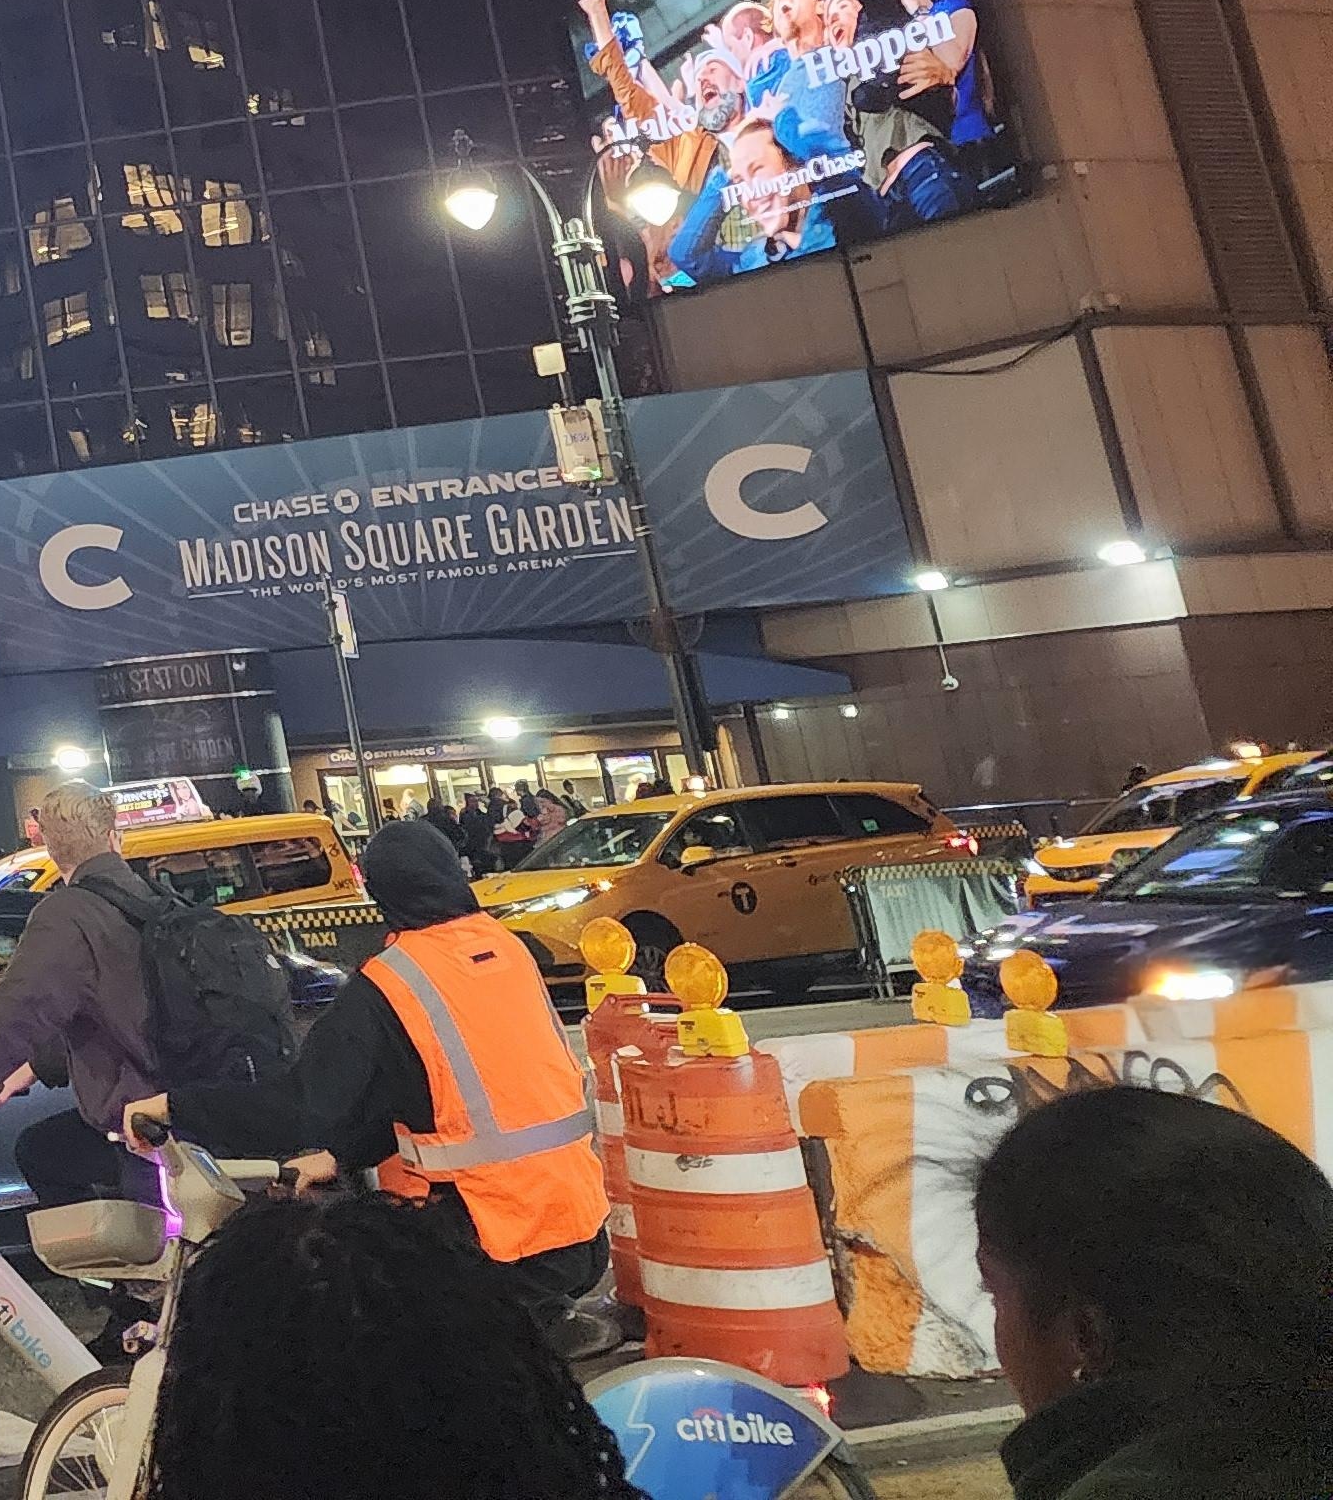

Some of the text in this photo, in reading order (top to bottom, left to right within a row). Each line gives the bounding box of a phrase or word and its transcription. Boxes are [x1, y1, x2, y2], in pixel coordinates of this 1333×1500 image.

[802, 10, 956, 90] Happen
[610, 102, 698, 158] Make
[720, 150, 866, 212] JPMorganChase
[232, 467, 562, 524] CHASE ENTRANCE
[704, 443, 829, 541] C
[38, 523, 135, 610] C
[179, 498, 636, 590] MADISON SQUARE GARDEN
[249, 585, 283, 600] THE
[286, 575, 364, 597] WORD'S
[370, 571, 421, 588] MOST
[426, 563, 501, 582] FAMOUS
[330, 752, 359, 762] CHAS
[735, 887, 750, 910] T
[300, 931, 338, 947] TAXI
